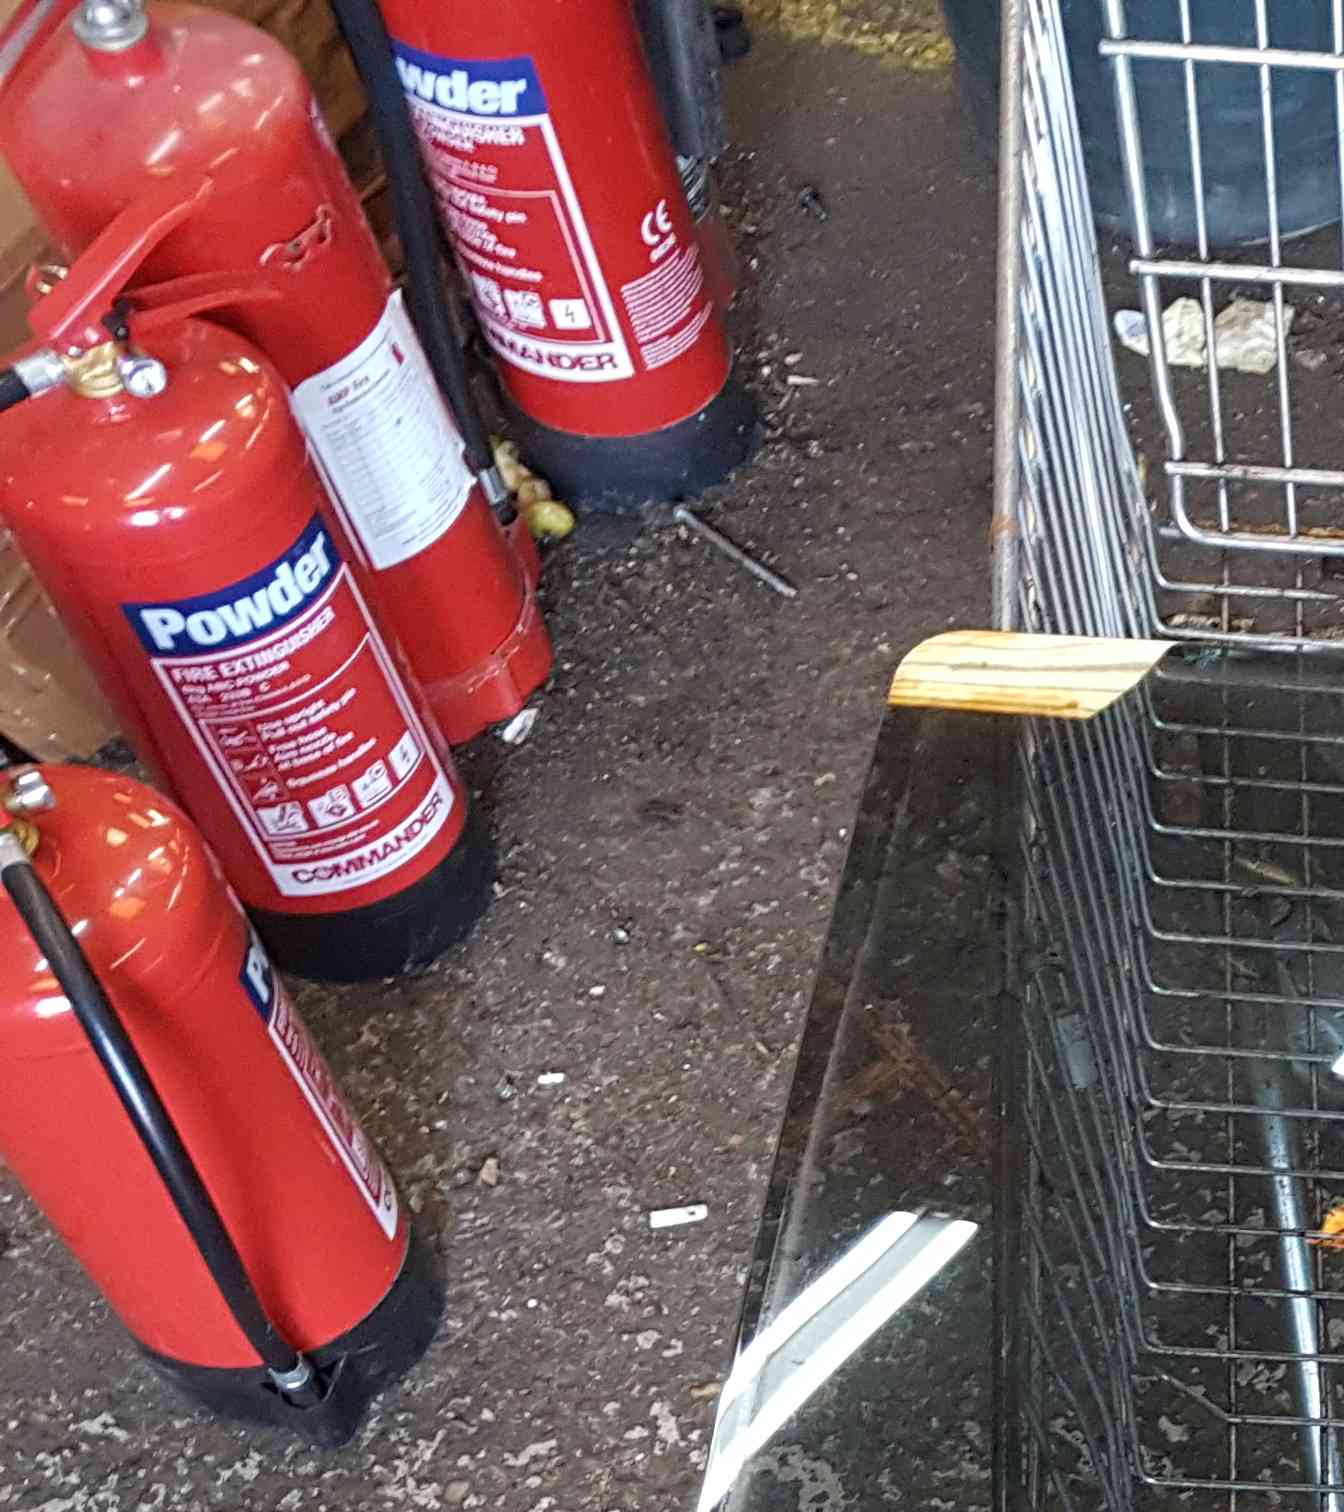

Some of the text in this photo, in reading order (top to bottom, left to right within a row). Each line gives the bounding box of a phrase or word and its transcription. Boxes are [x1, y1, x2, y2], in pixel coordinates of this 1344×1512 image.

[395, 56, 527, 115] wder
[141, 530, 331, 651] Powder
[172, 605, 336, 684] FIRE EXTINGUISHER
[291, 791, 446, 884] COMMANDER
